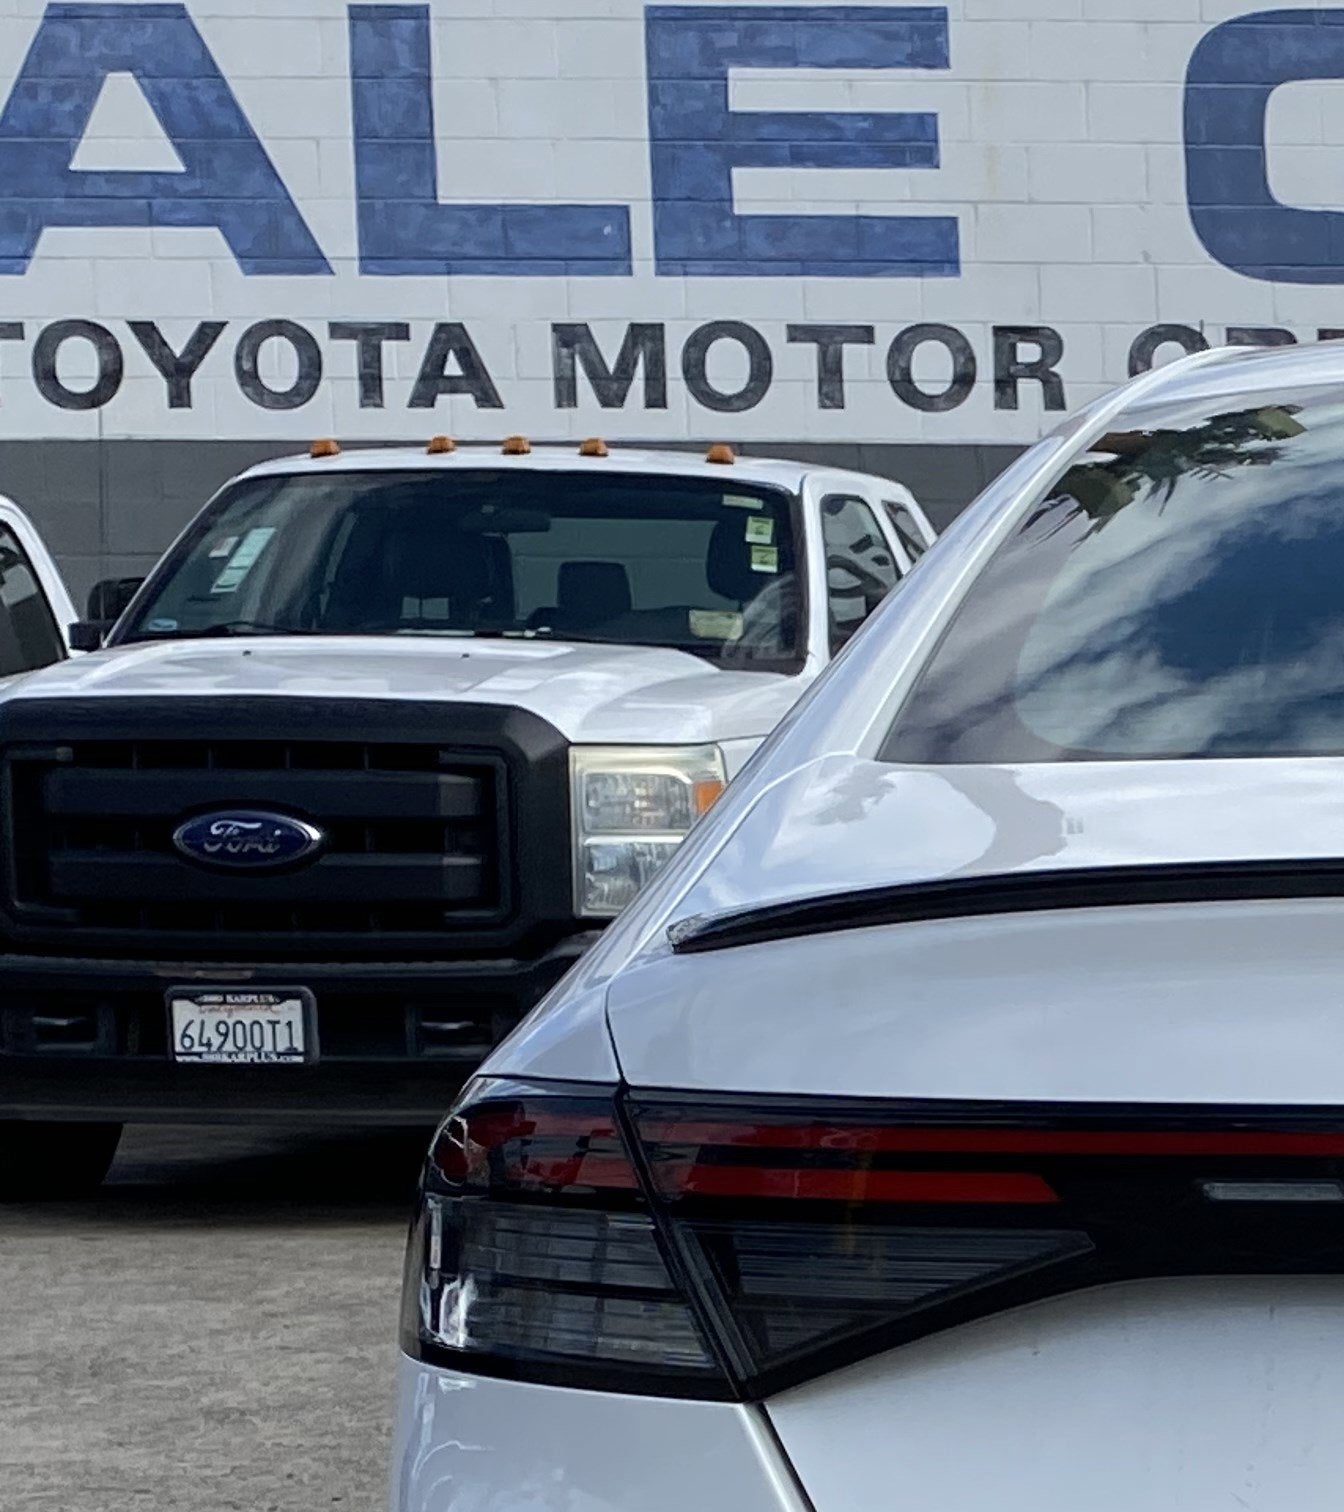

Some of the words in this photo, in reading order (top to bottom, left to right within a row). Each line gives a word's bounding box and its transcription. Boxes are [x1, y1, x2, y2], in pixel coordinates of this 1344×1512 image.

[0, 2, 961, 277] ALE
[551, 321, 1068, 413] MOTOR
[179, 1018, 299, 1052] 64900T1
